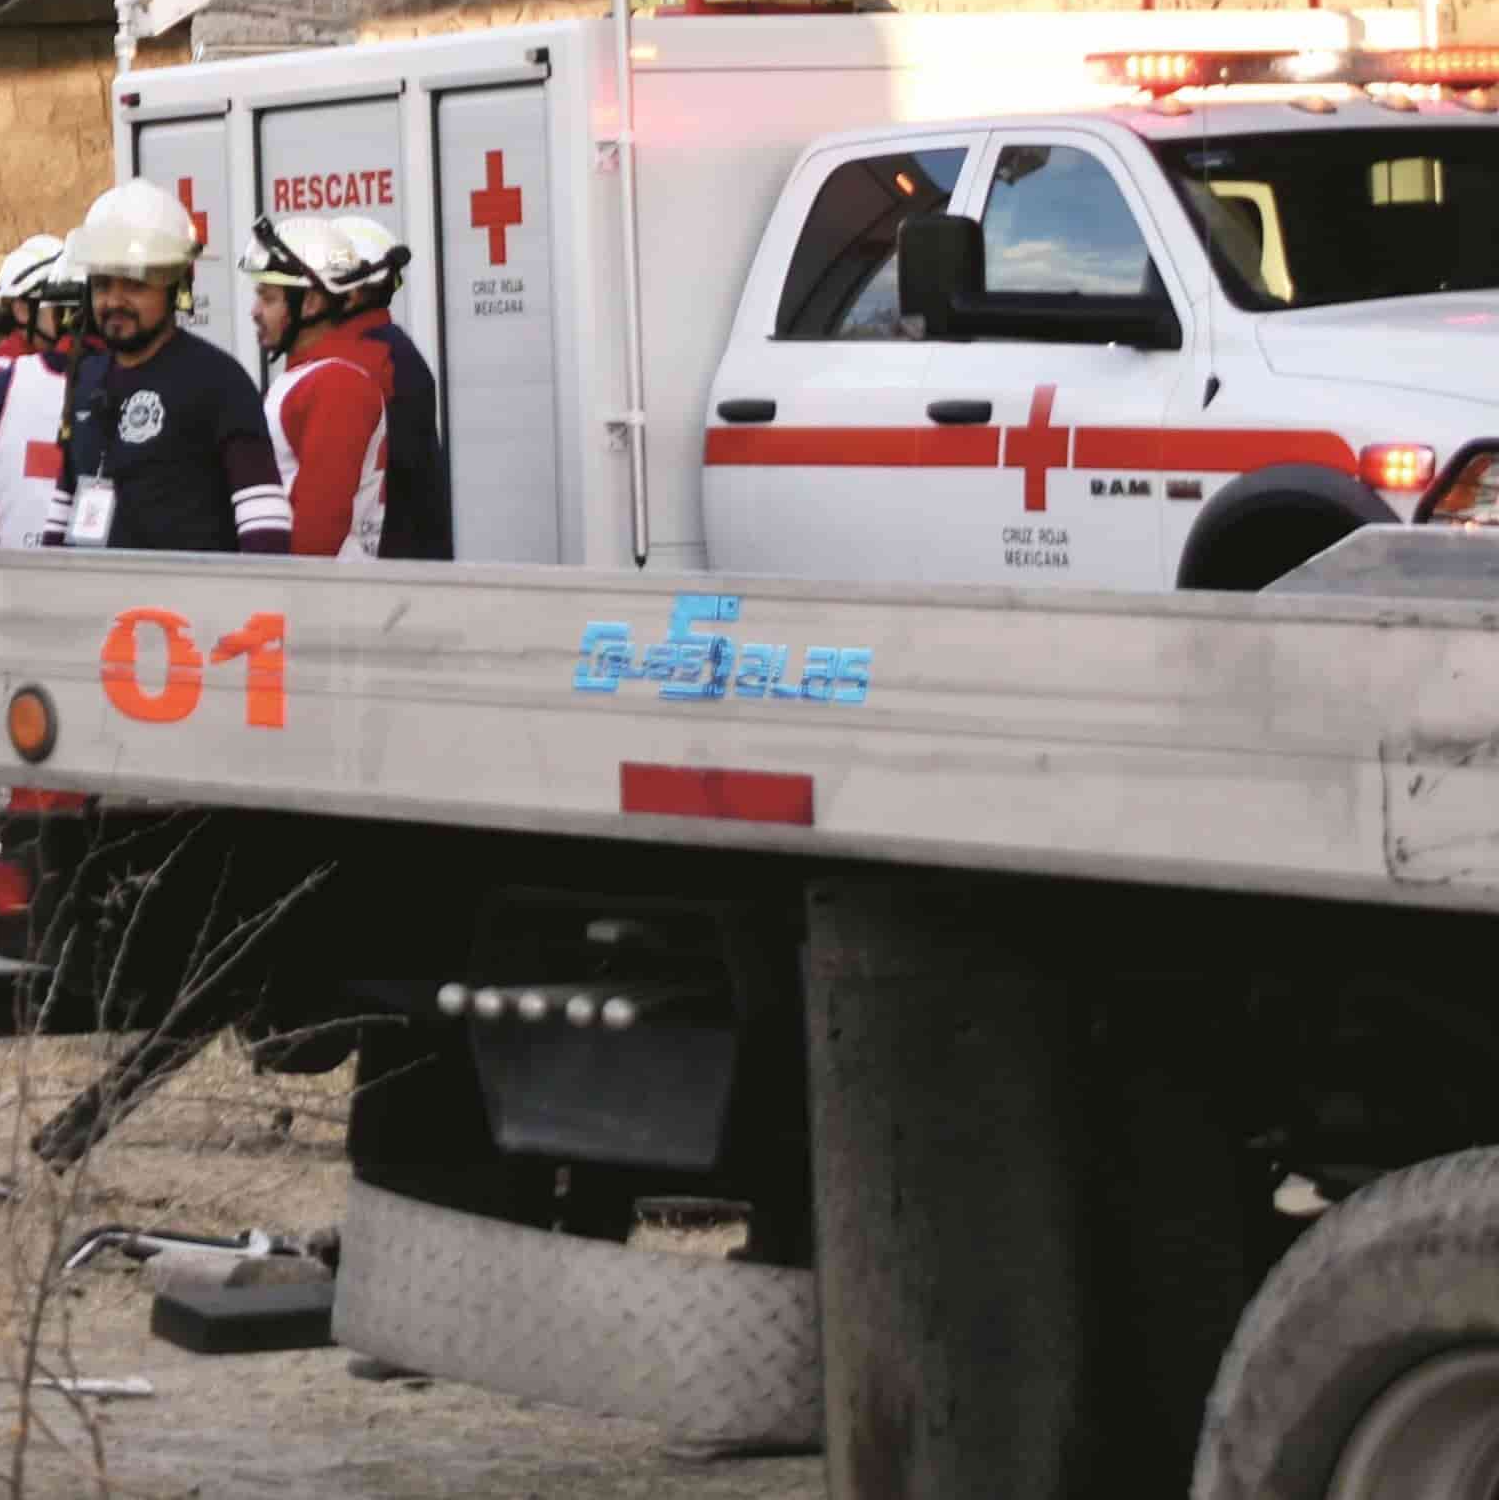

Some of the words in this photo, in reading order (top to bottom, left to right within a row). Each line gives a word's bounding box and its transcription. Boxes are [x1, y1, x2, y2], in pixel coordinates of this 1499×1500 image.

[274, 169, 394, 213] RESCATE
[472, 280, 495, 295] CRUZ
[474, 299, 524, 316] MEXICANA
[1090, 479, 1152, 497] RAM
[1002, 527, 1032, 544] CRUZ
[1038, 527, 1068, 546] ROJA
[1004, 549, 1069, 568] MEXICANA
[101, 607, 287, 730] 01
